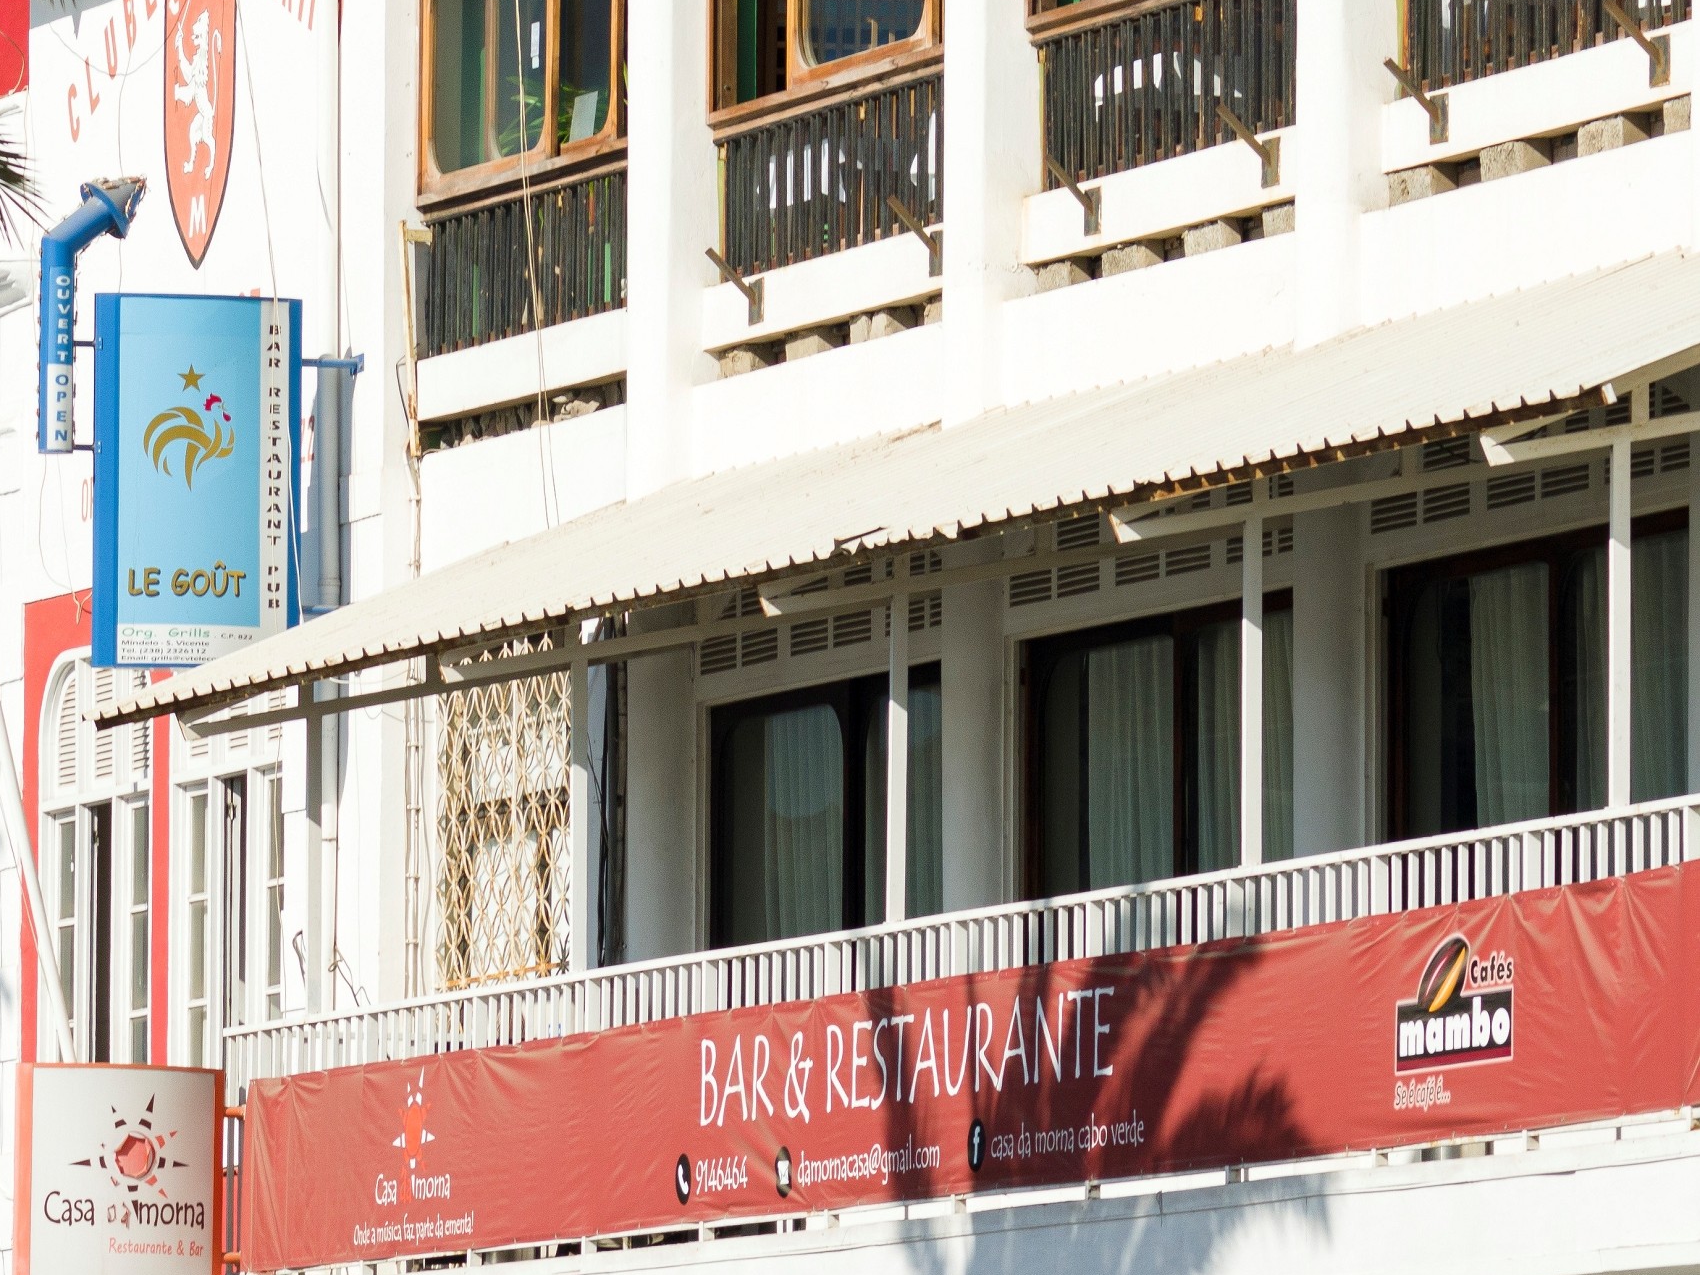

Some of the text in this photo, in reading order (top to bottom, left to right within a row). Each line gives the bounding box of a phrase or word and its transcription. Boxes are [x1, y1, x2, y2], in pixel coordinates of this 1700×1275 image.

[189, 195, 206, 237] M
[56, 276, 70, 362] OUVERT
[55, 375, 69, 441] OPEN
[267, 325, 281, 609] BAR RESTAURANT PUB
[128, 560, 246, 597] LE GOÛT
[168, 627, 210, 638] Grills
[1471, 955, 1512, 984] Cafés
[1400, 996, 1510, 1057] mambo
[701, 986, 1115, 1127] BAR & RESTAURANTE
[1396, 1084, 1406, 1106] Se
[1409, 1081, 1414, 1105] é
[1416, 1078, 1434, 1109] café
[991, 1132, 1013, 1160] casa
[1018, 1122, 1031, 1159] da
[1035, 1128, 1074, 1154] morna
[1078, 1112, 1107, 1151] cabo
[1111, 1109, 1144, 1148] verde
[696, 1155, 748, 1195] 9146464
[798, 1134, 940, 1187] damornacasa@gmail.com
[375, 1173, 397, 1206] Casa
[416, 1174, 450, 1200] morna
[44, 1191, 95, 1226] Casa
[138, 1201, 205, 1229] morna
[354, 1210, 474, 1246] Onde a música faz parte da ementa!
[109, 1238, 204, 1257] Restaurante & Bar
